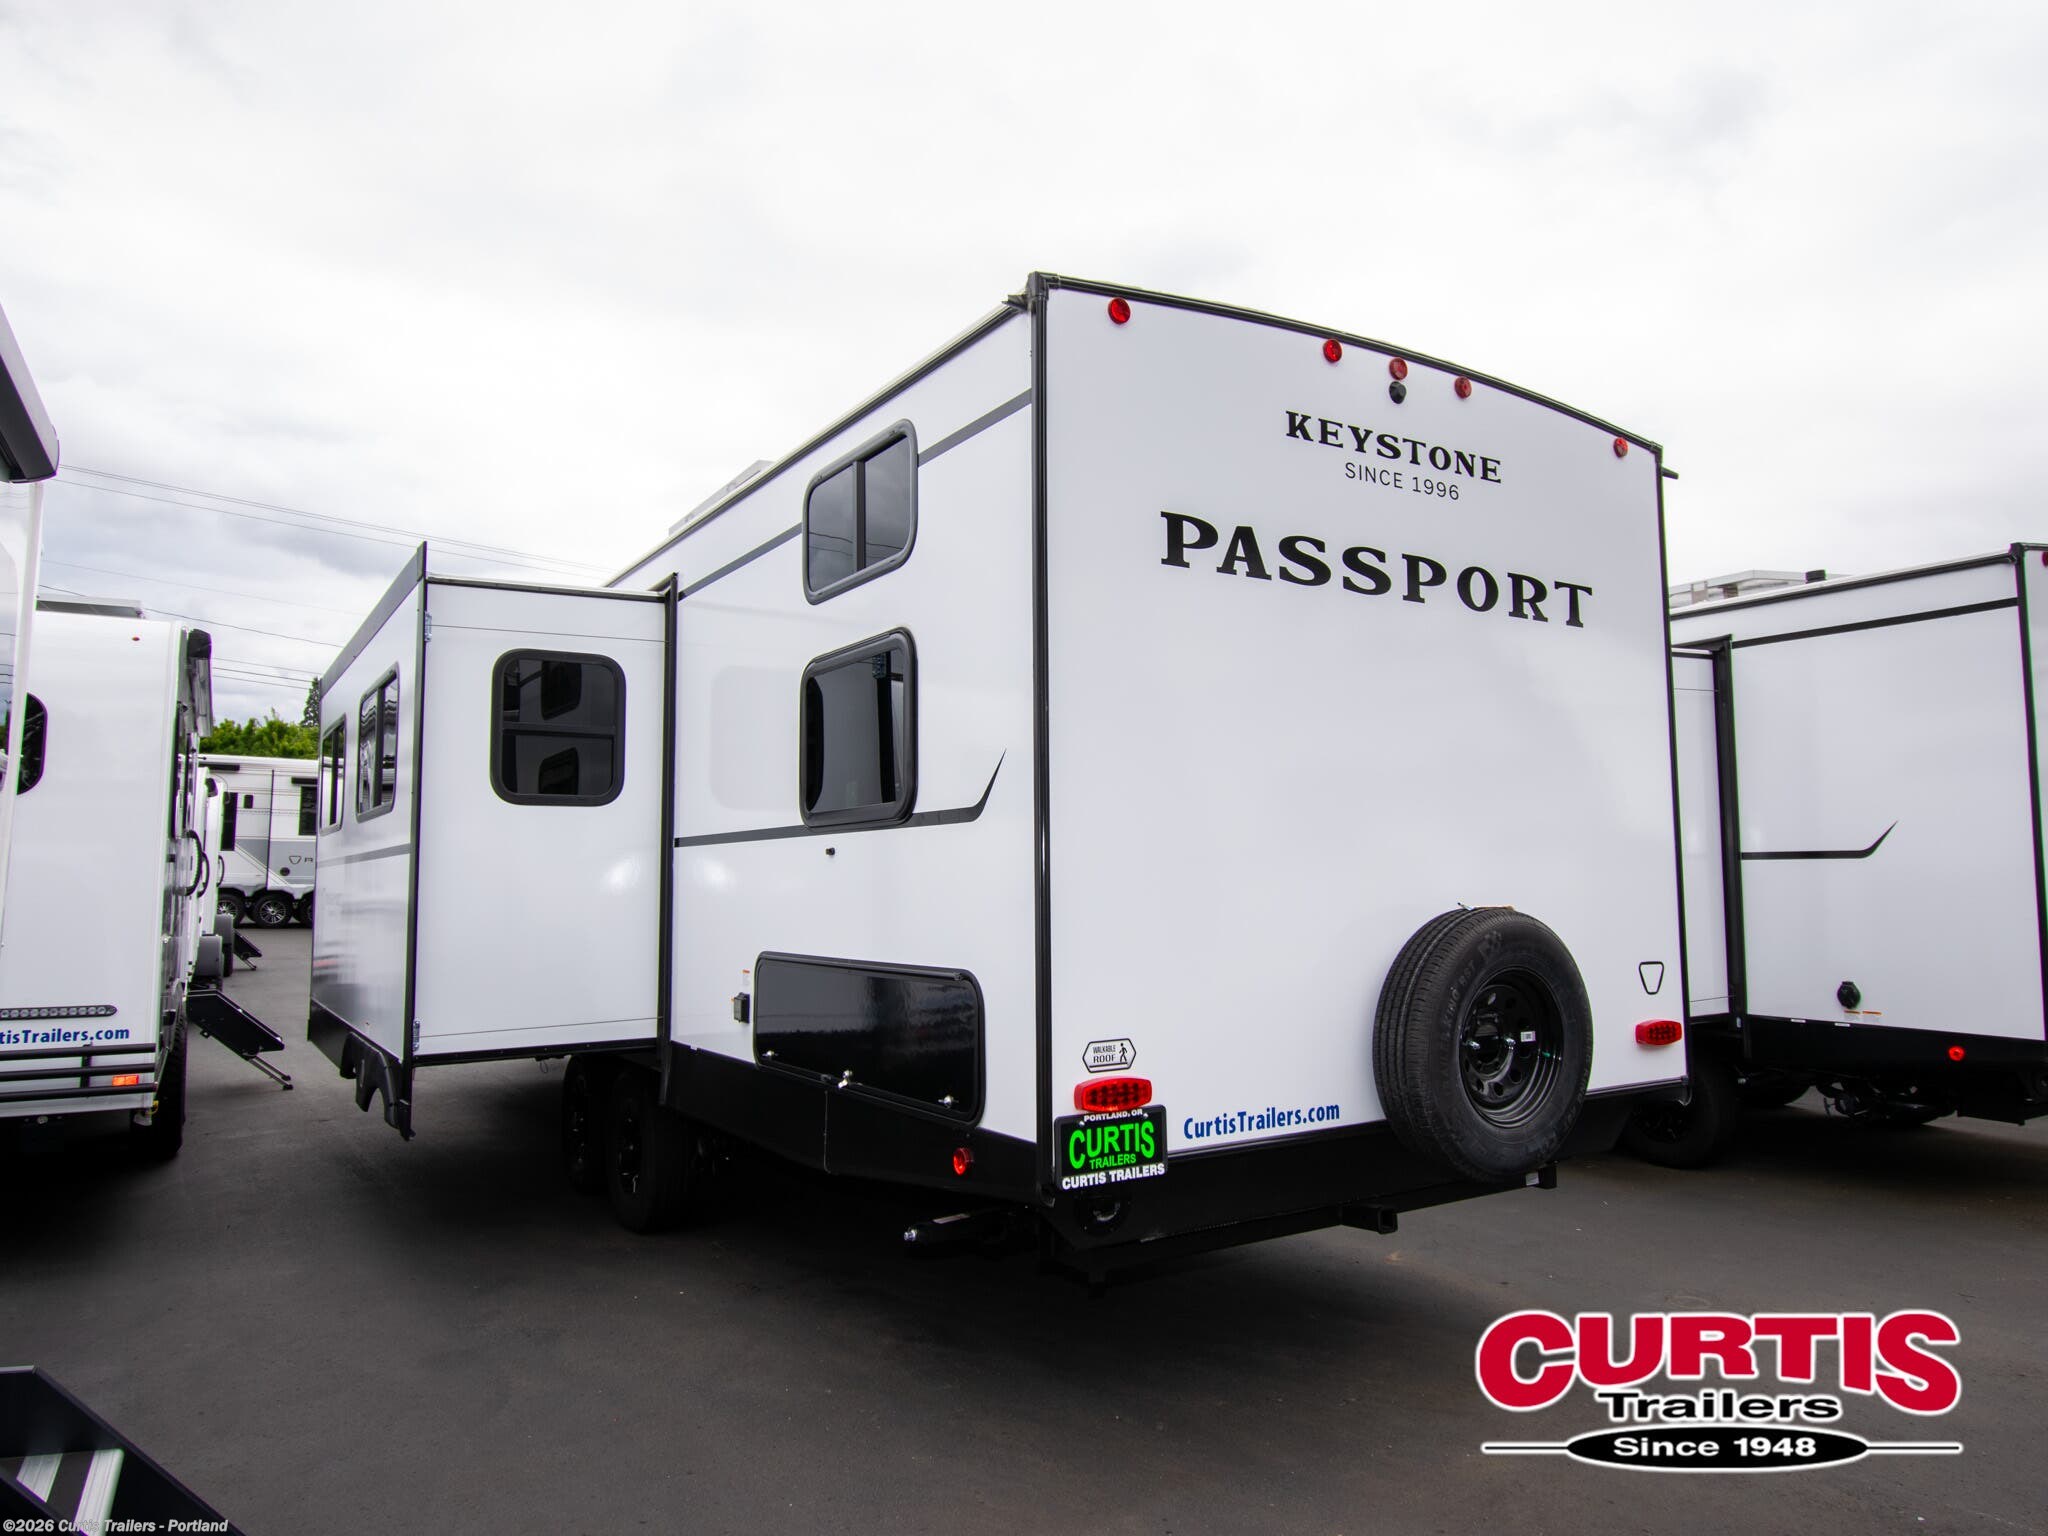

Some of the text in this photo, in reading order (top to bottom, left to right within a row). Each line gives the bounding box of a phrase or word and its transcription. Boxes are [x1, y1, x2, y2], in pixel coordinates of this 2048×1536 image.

[1286, 411, 1501, 483] KEYSTONE
[1345, 462, 1459, 500] SINCE 1996
[1161, 511, 1592, 628] PASSPORT
[1093, 1054, 1116, 1063] ROOF
[1184, 1103, 1340, 1140] CurtisTrailers.com
[1068, 1120, 1155, 1169] CURTIS
[1089, 1154, 1136, 1169] TRAILERS
[1062, 1163, 1165, 1190] CURTIS TRAILERS
